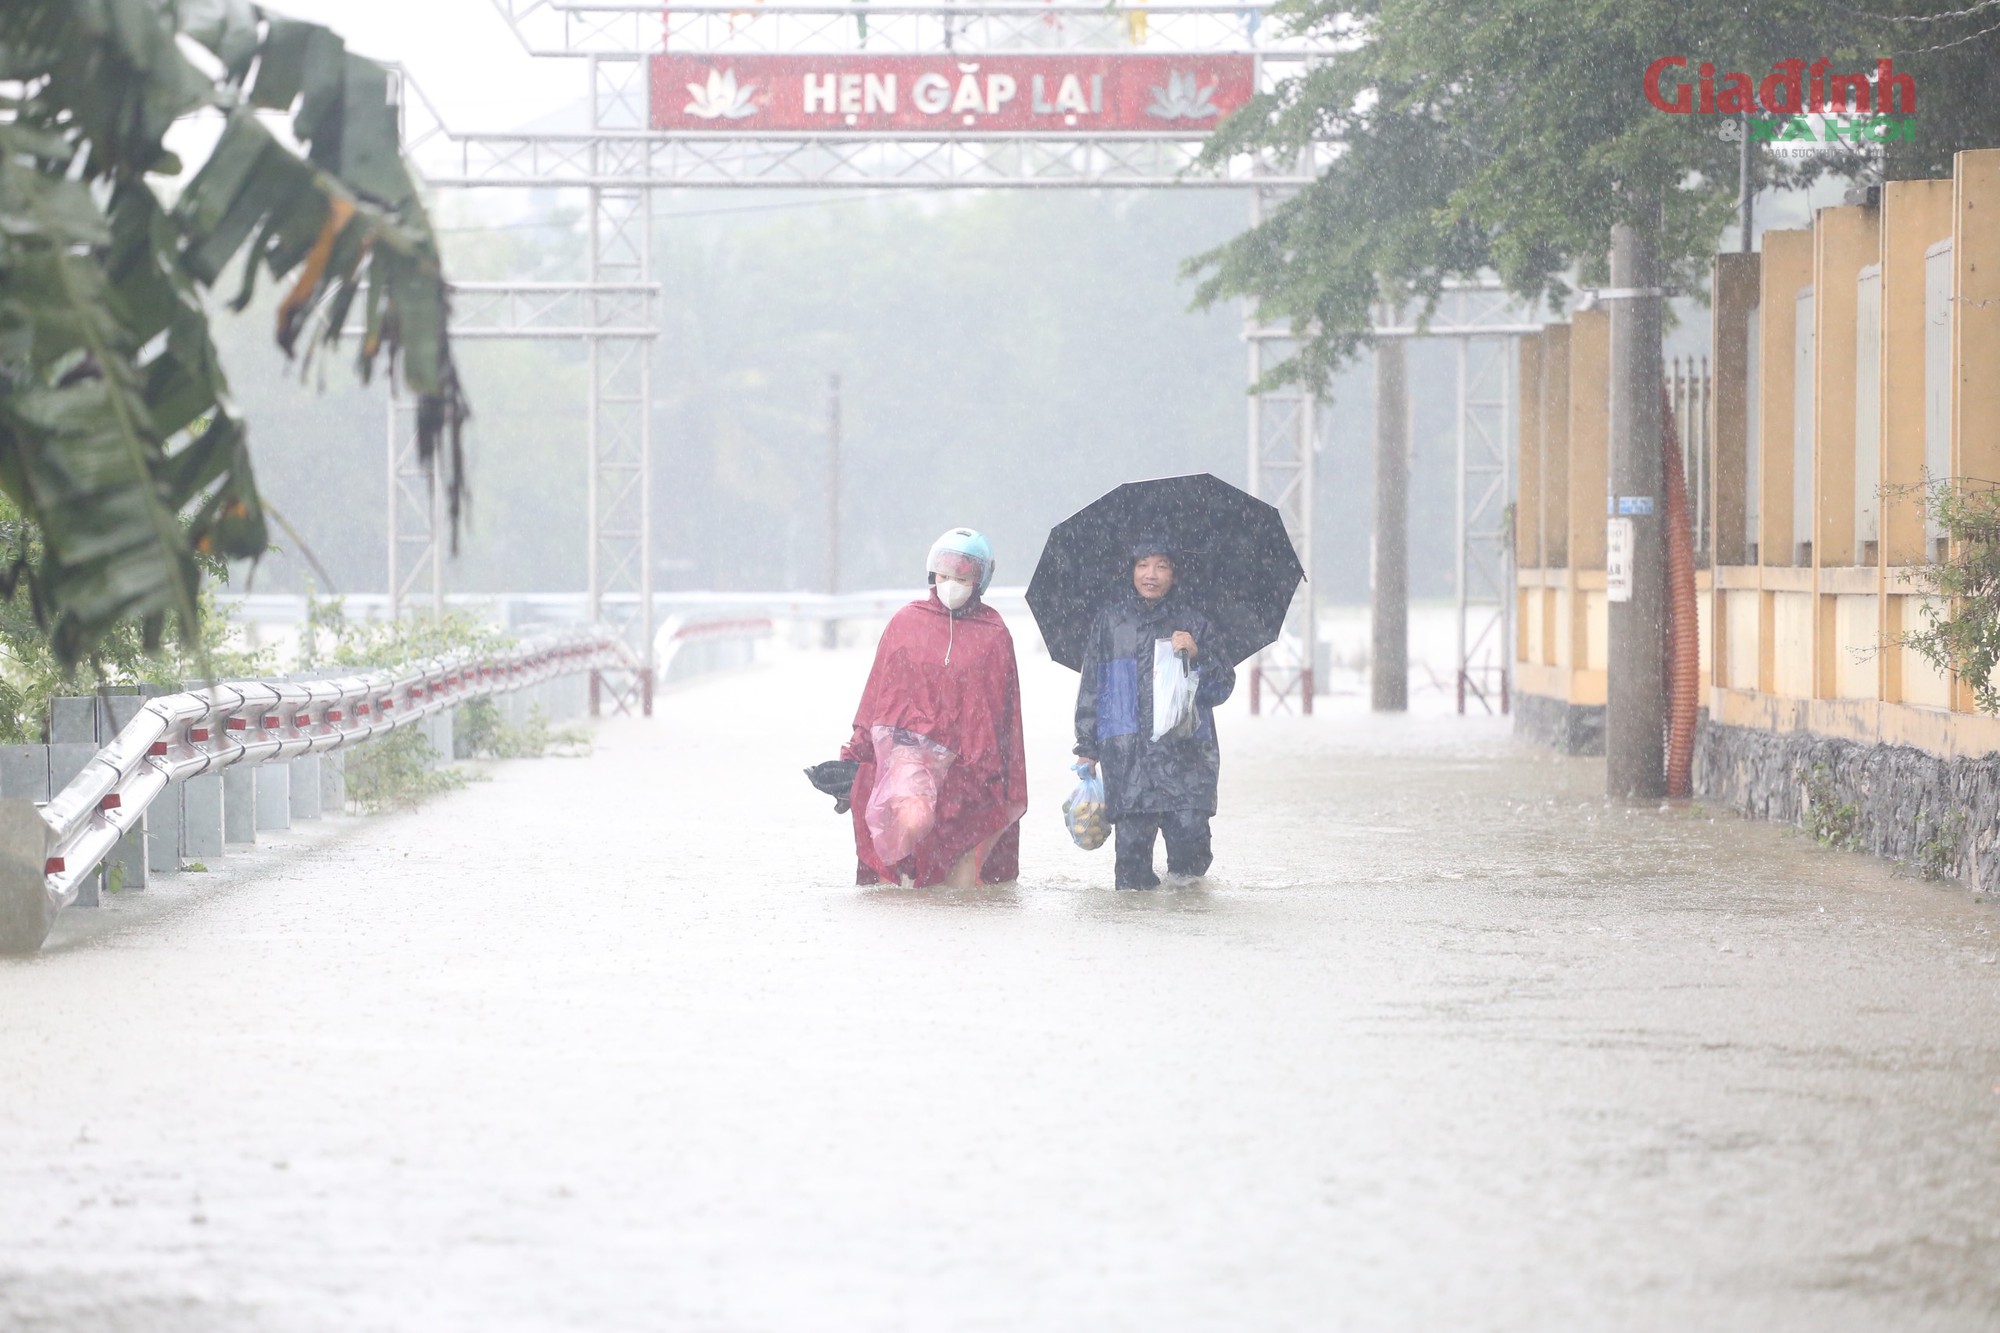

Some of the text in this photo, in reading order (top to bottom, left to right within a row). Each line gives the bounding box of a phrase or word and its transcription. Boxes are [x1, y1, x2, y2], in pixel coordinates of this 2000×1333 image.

[803, 62, 1104, 126] HẸN GẶP LẠI
